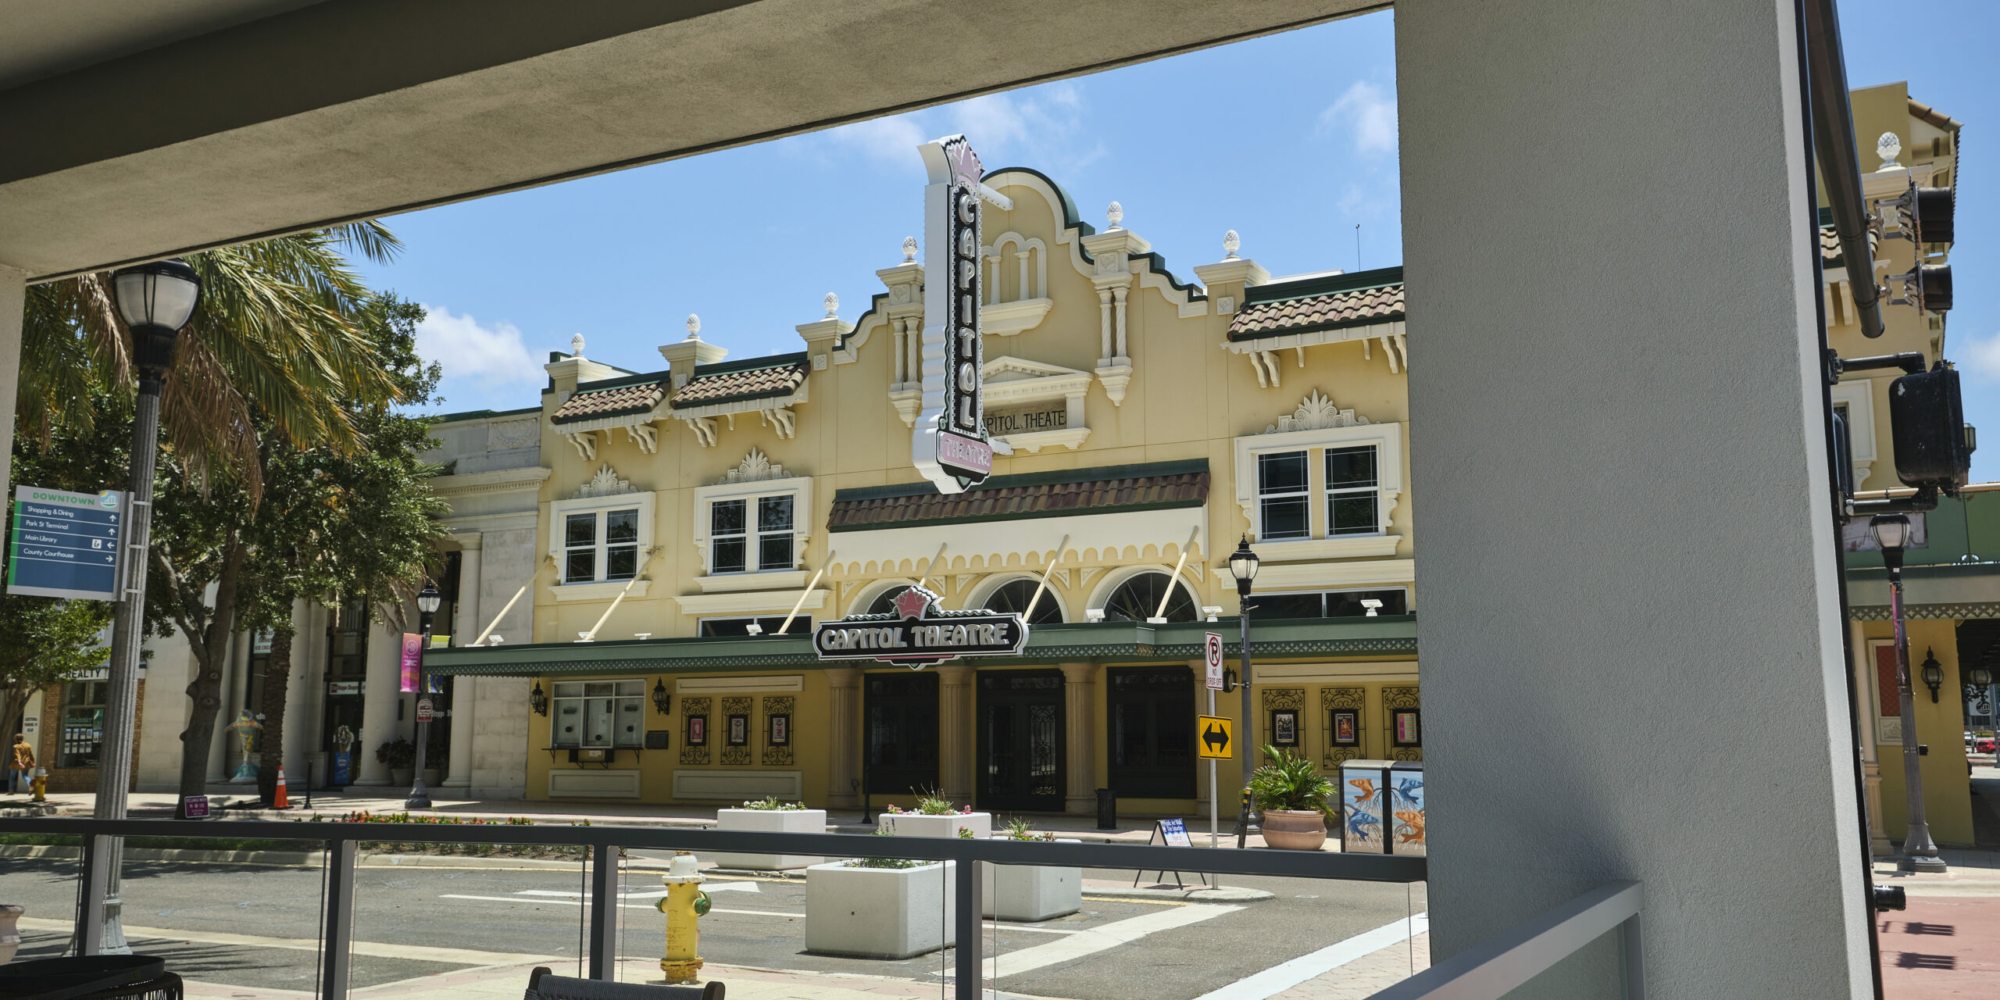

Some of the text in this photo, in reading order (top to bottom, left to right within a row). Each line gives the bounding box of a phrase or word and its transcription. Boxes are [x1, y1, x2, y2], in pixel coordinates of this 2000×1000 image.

[959, 194, 976, 428] CAPITOL
[1023, 409, 1066, 429] THEATE
[945, 439, 990, 467] THEATRE
[33, 492, 95, 505] DOWNTOWN
[27, 506, 52, 515] Shopping
[58, 510, 74, 518] Dining
[46, 522, 68, 530] Terminal
[40, 535, 57, 544] Library
[23, 548, 74, 558] County Courthouse
[821, 623, 1010, 650] CAPITOL THEATRE
